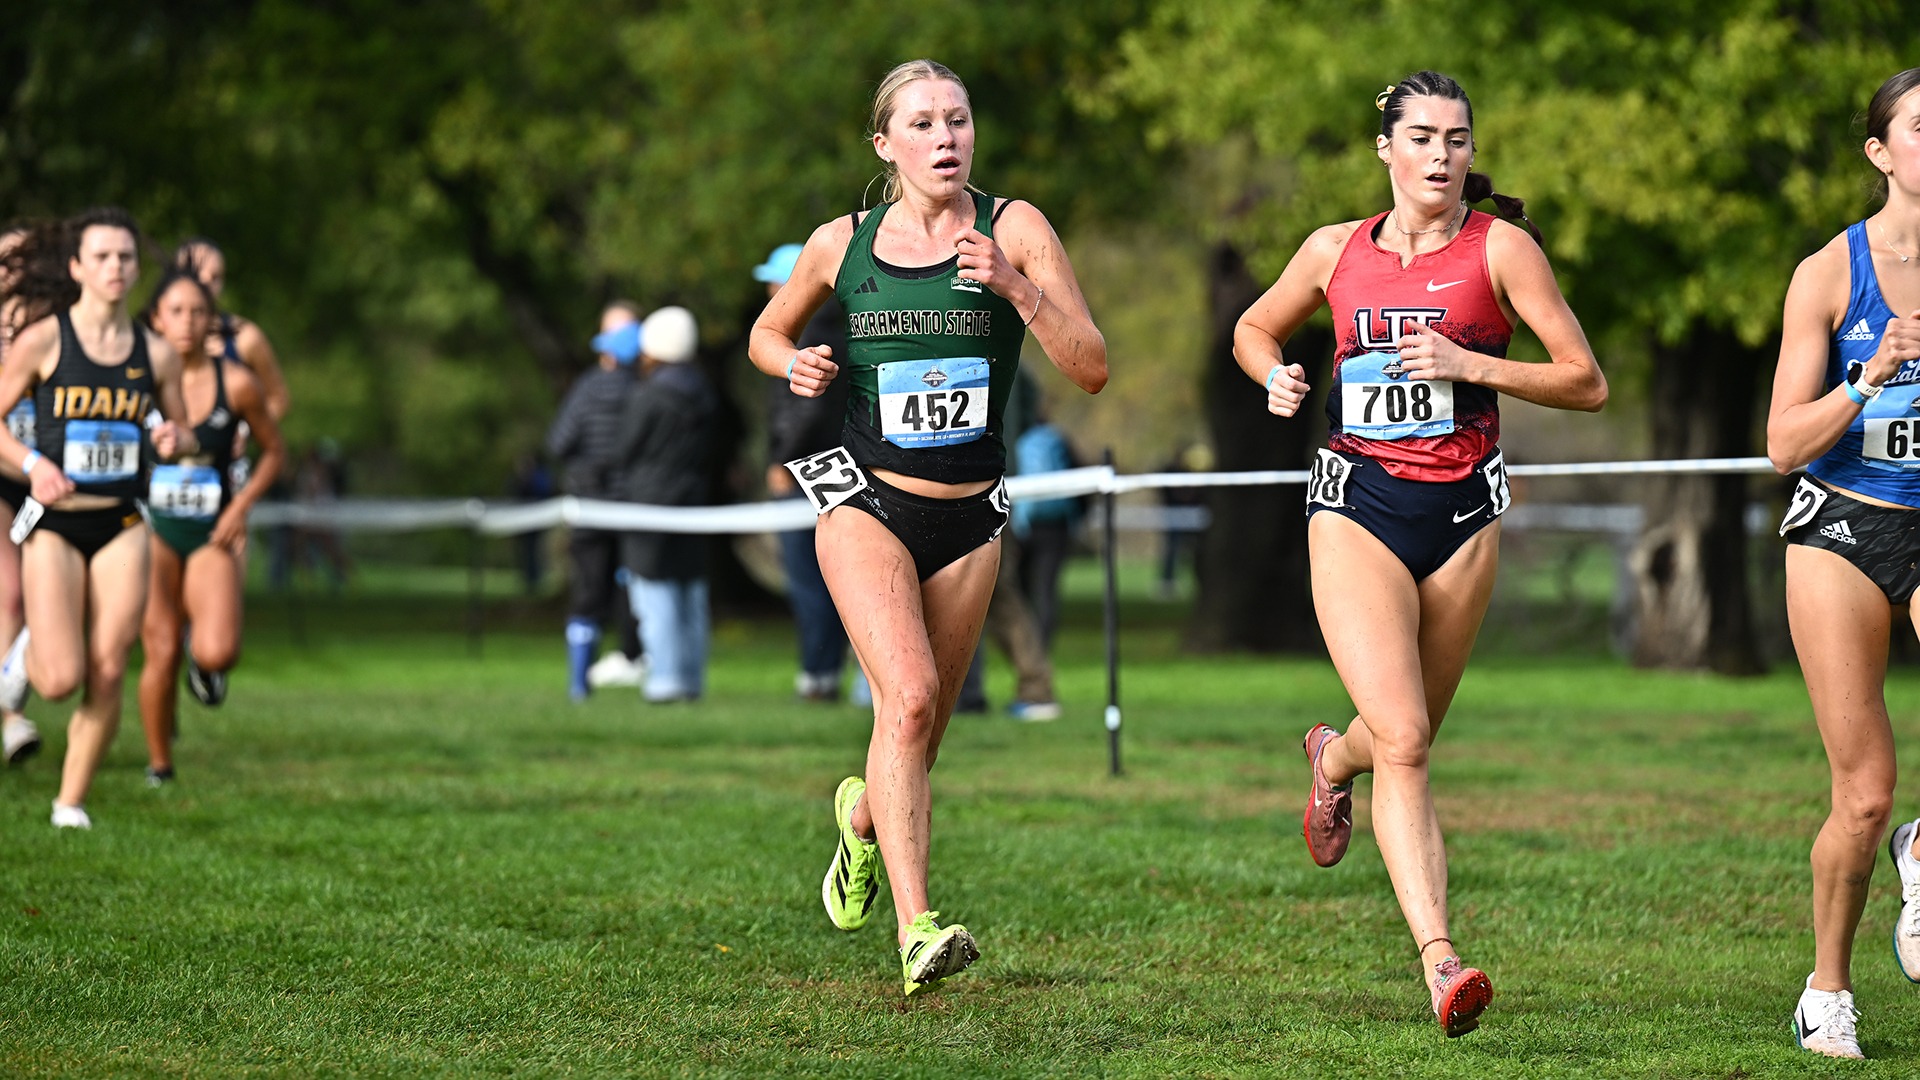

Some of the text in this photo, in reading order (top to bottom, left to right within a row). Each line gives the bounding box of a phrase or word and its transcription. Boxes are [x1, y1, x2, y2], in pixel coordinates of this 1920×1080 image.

[849, 310, 991, 338] SACRAMENTO STATE
[902, 390, 970, 431] 452
[1362, 383, 1433, 424] 708
[1820, 528, 1857, 545] adidas
